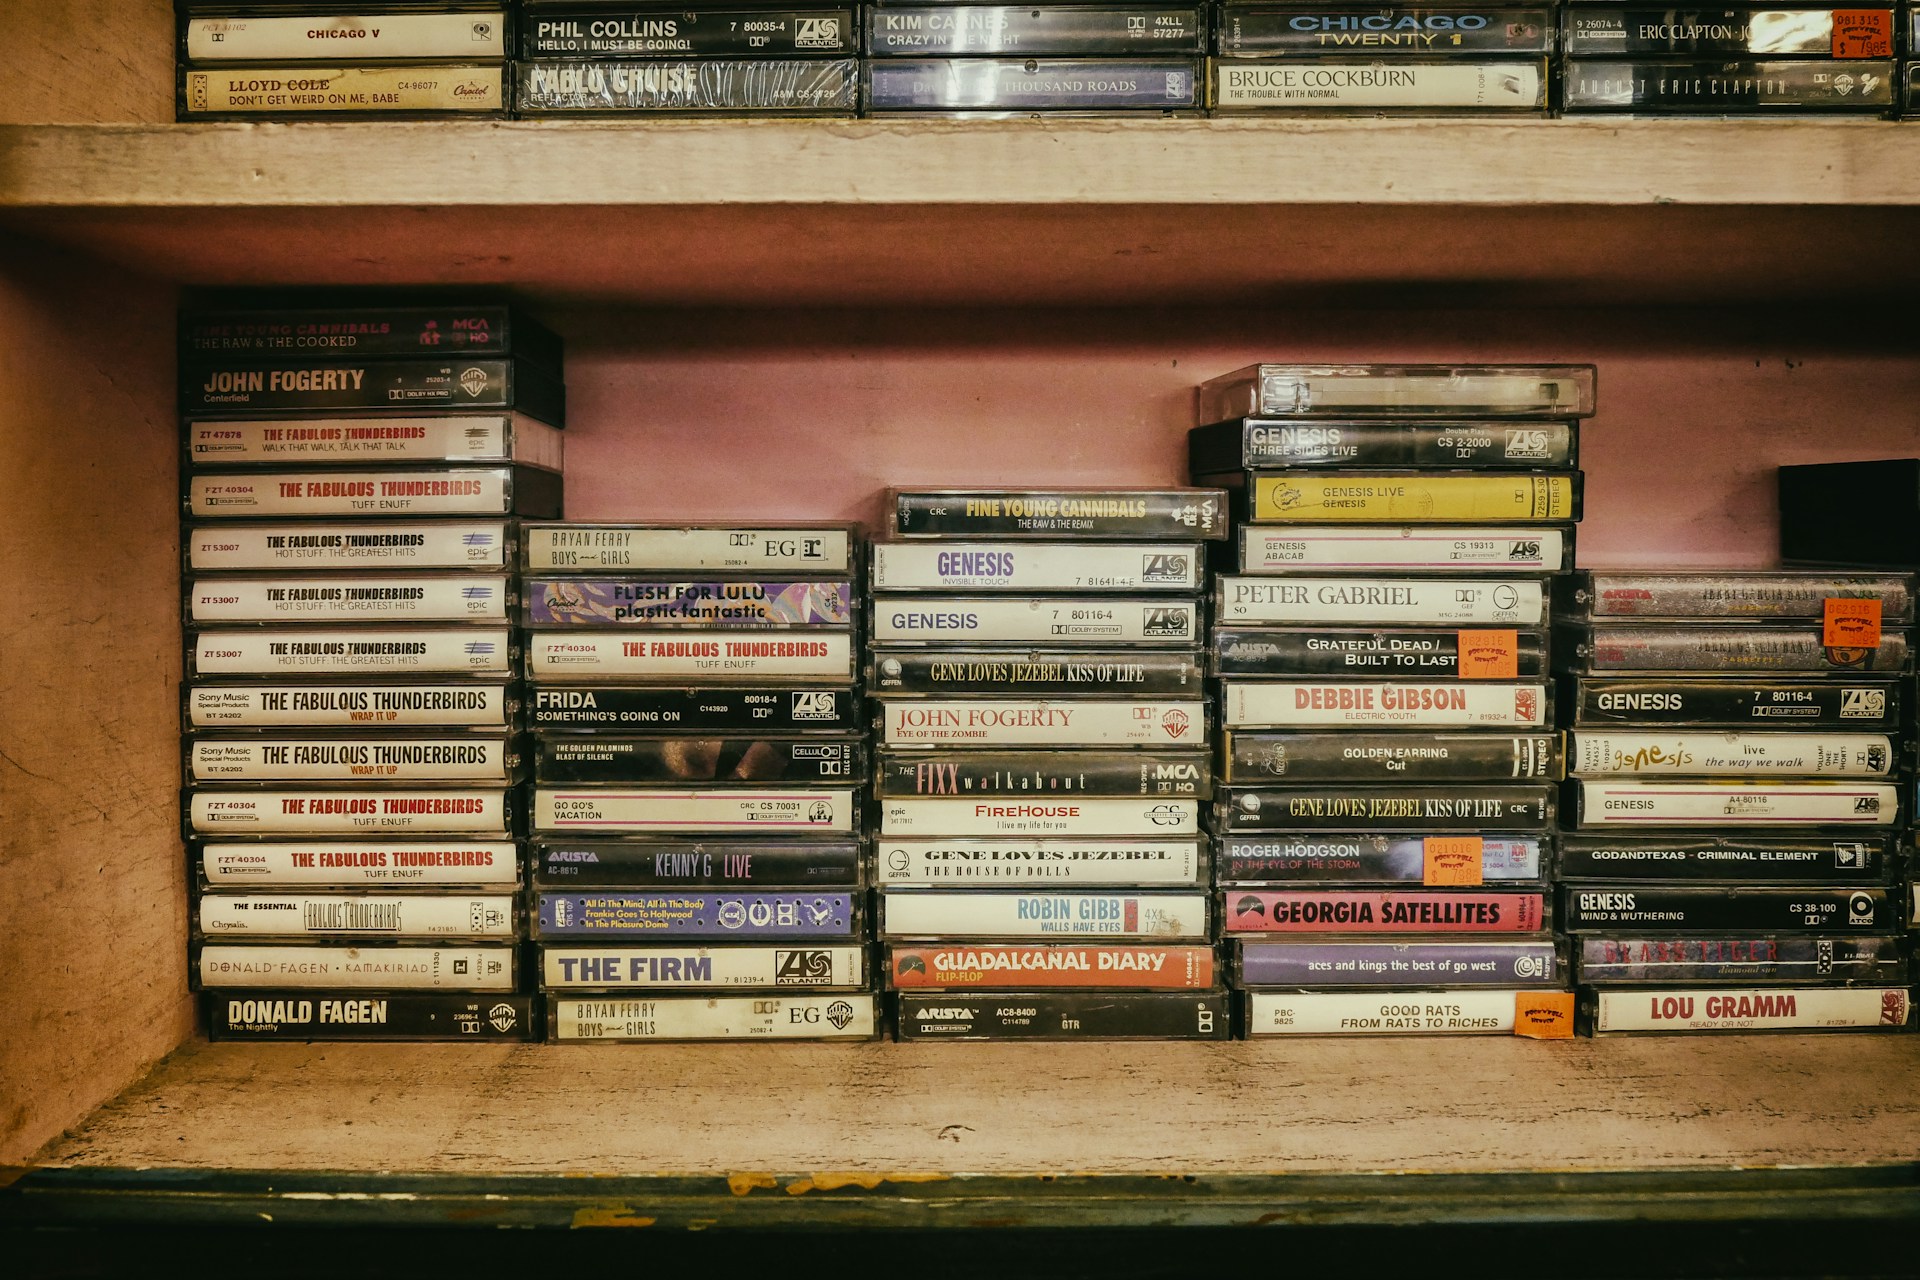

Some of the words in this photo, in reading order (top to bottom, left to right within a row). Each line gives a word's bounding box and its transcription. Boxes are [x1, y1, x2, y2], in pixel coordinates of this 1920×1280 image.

[731, 22, 736, 31] 7
[744, 22, 785, 31] 80035-4
[1155, 17, 1182, 25] 4XLL
[1289, 16, 1487, 29] CHICAGO
[1577, 20, 1582, 28] 9
[1586, 20, 1622, 28] 26074-4
[308, 30, 366, 38] CHICAGO
[372, 29, 380, 37] V
[539, 22, 583, 37] PHIL
[591, 21, 677, 37] COLLINS
[1154, 29, 1184, 38] 57277
[1314, 34, 1439, 45] TWENTY
[1450, 34, 1462, 44] 1
[537, 40, 579, 51] HELLO,
[584, 41, 587, 50] I
[591, 41, 622, 50] MUST
[627, 40, 643, 50] BE
[647, 40, 691, 50] GOING!
[1230, 71, 1296, 86] BRUCE
[1303, 71, 1414, 86] COCKBURN
[230, 81, 281, 91] LLOYD
[287, 80, 329, 90] COLE
[1580, 80, 1645, 94] AUGUST
[1659, 79, 1700, 94] ERIC
[1710, 80, 1785, 95] CLAPTON
[230, 96, 263, 105] DON'T
[268, 95, 289, 104] GET
[291, 95, 324, 104] WEIRD
[329, 94, 345, 103] ON
[350, 94, 368, 104] ME,
[373, 94, 399, 102] BABE
[1231, 90, 1243, 98] THE
[1248, 90, 1281, 98] TROUBLE
[1285, 90, 1305, 98] WITH
[1308, 90, 1339, 98] NORMAL
[205, 372, 263, 392] JOHN
[270, 370, 364, 391] FOGERTY
[204, 394, 249, 402] Centerfield
[1438, 438, 1454, 447] CS
[1457, 438, 1491, 447] 2-2000
[1323, 488, 1373, 496] GENESIS
[1378, 487, 1404, 496] LIVE
[267, 537, 287, 548] THE
[289, 536, 341, 547] FABULOUS
[346, 534, 424, 548] THUNDERBIRDS
[553, 533, 590, 546] BRYAN
[596, 533, 630, 546] FERRY
[1265, 542, 1306, 550] GENESIS
[276, 549, 293, 557] HOT
[329, 548, 345, 557] THE
[348, 549, 392, 557] GREATEST
[396, 548, 415, 556] HITS
[938, 553, 1014, 576] GENESIS
[615, 587, 669, 600] FLESH
[675, 587, 714, 600] FOR
[717, 587, 765, 601] LULU
[1234, 586, 1310, 603] PETER
[1318, 587, 1418, 605] GABRIEL
[615, 604, 677, 621] plastic
[682, 604, 764, 618] fantastic
[1053, 610, 1058, 619] 7
[1072, 610, 1112, 619] 80116-4
[198, 694, 220, 702] Sony
[537, 692, 596, 708] FRIDA
[1295, 689, 1373, 710] DEBBIE
[1381, 687, 1465, 710] GIBSON
[1598, 694, 1682, 709] GENESIS
[537, 712, 616, 721] SOMETHING'S
[620, 712, 658, 721] GOING
[663, 712, 680, 721] ON
[896, 710, 960, 730] JOHN
[968, 710, 1073, 726] FOGERTY
[1344, 748, 1392, 759] GOLDEN
[1397, 748, 1448, 758] EARRING
[1386, 760, 1405, 770] Cut
[1605, 801, 1654, 809] GENESIS
[1232, 845, 1281, 857] ROGER
[1285, 844, 1359, 857] HODGSON
[1592, 851, 1685, 859] GODANDTEXAS
[1760, 852, 1818, 860] ELEMENT
[655, 854, 698, 877] KENNY
[702, 854, 712, 877] G
[725, 855, 753, 877] LIVE
[1580, 894, 1635, 910] GENESIS
[1017, 897, 1071, 919] ROBIN
[1079, 899, 1120, 919] GIBB
[1273, 901, 1373, 922] GEORGIA
[1382, 902, 1499, 923] SATELLITES
[586, 910, 613, 918] Frankie
[616, 910, 635, 919] Goes
[639, 910, 648, 918] To
[651, 910, 693, 919] Hollywood
[1581, 912, 1608, 920] WIND
[1610, 912, 1617, 920] &
[1620, 912, 1684, 920] WUTHERING
[934, 951, 1090, 971] GUADALCANAL
[1098, 953, 1166, 971] DIARY
[210, 963, 271, 972] DONALD
[281, 963, 328, 973] FAGEN
[346, 964, 428, 972] KAMAKIRIAD
[559, 958, 621, 981] THE
[630, 958, 711, 981] FIRM
[936, 972, 983, 982] FLIP-FLOP
[229, 1001, 312, 1024] DONALD
[320, 1001, 387, 1023] FAGEN
[996, 1008, 1036, 1016] AC8-8400
[1381, 1006, 1420, 1016] GOOD
[1426, 1006, 1460, 1016] RATS
[1652, 998, 1695, 1020] LOU
[1706, 996, 1796, 1018] GRAMM
[245, 1024, 278, 1032] Nightfly
